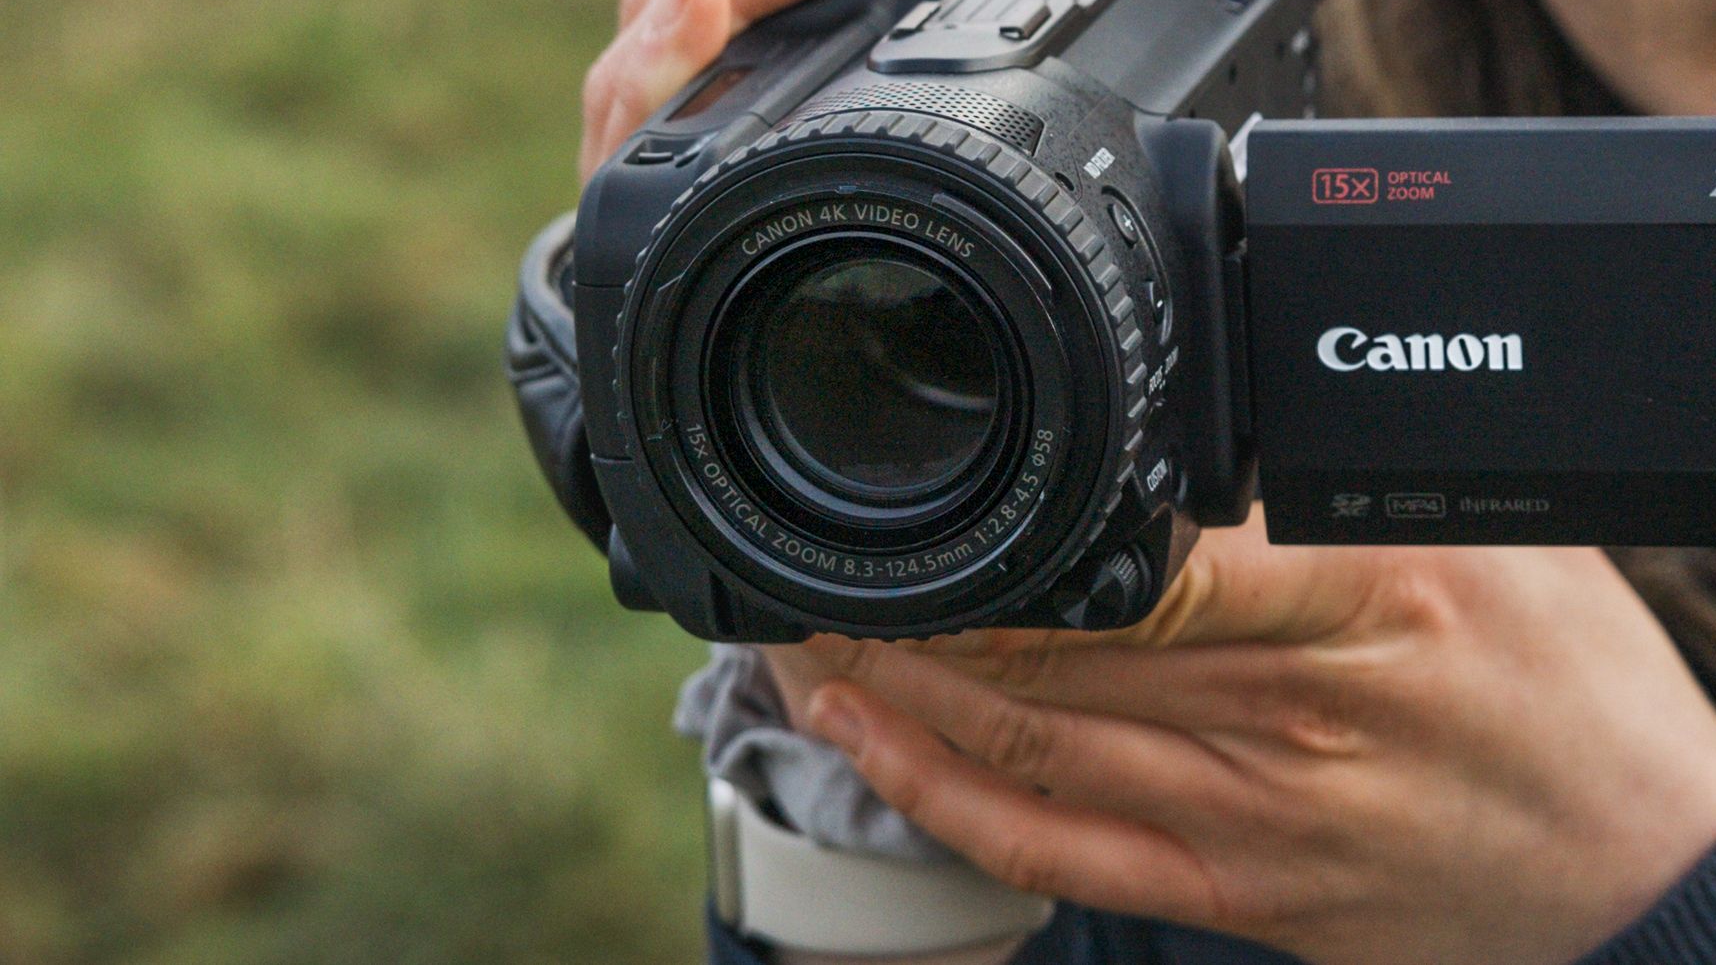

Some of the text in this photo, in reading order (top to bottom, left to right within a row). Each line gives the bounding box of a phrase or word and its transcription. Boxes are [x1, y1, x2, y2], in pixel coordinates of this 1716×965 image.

[1387, 171, 1452, 184] OPTICAL
[1387, 186, 1435, 200] ZOOM
[741, 203, 976, 258] CANON 4K VIDEO LENS
[1317, 326, 1524, 372] Canon
[703, 463, 770, 538] OPTICAL
[771, 532, 837, 572] ZOOM
[843, 542, 974, 578] 8.3-124.5mm
[974, 472, 1039, 546] 1:2.8-4.5
[1459, 495, 1551, 514] INFRARED
